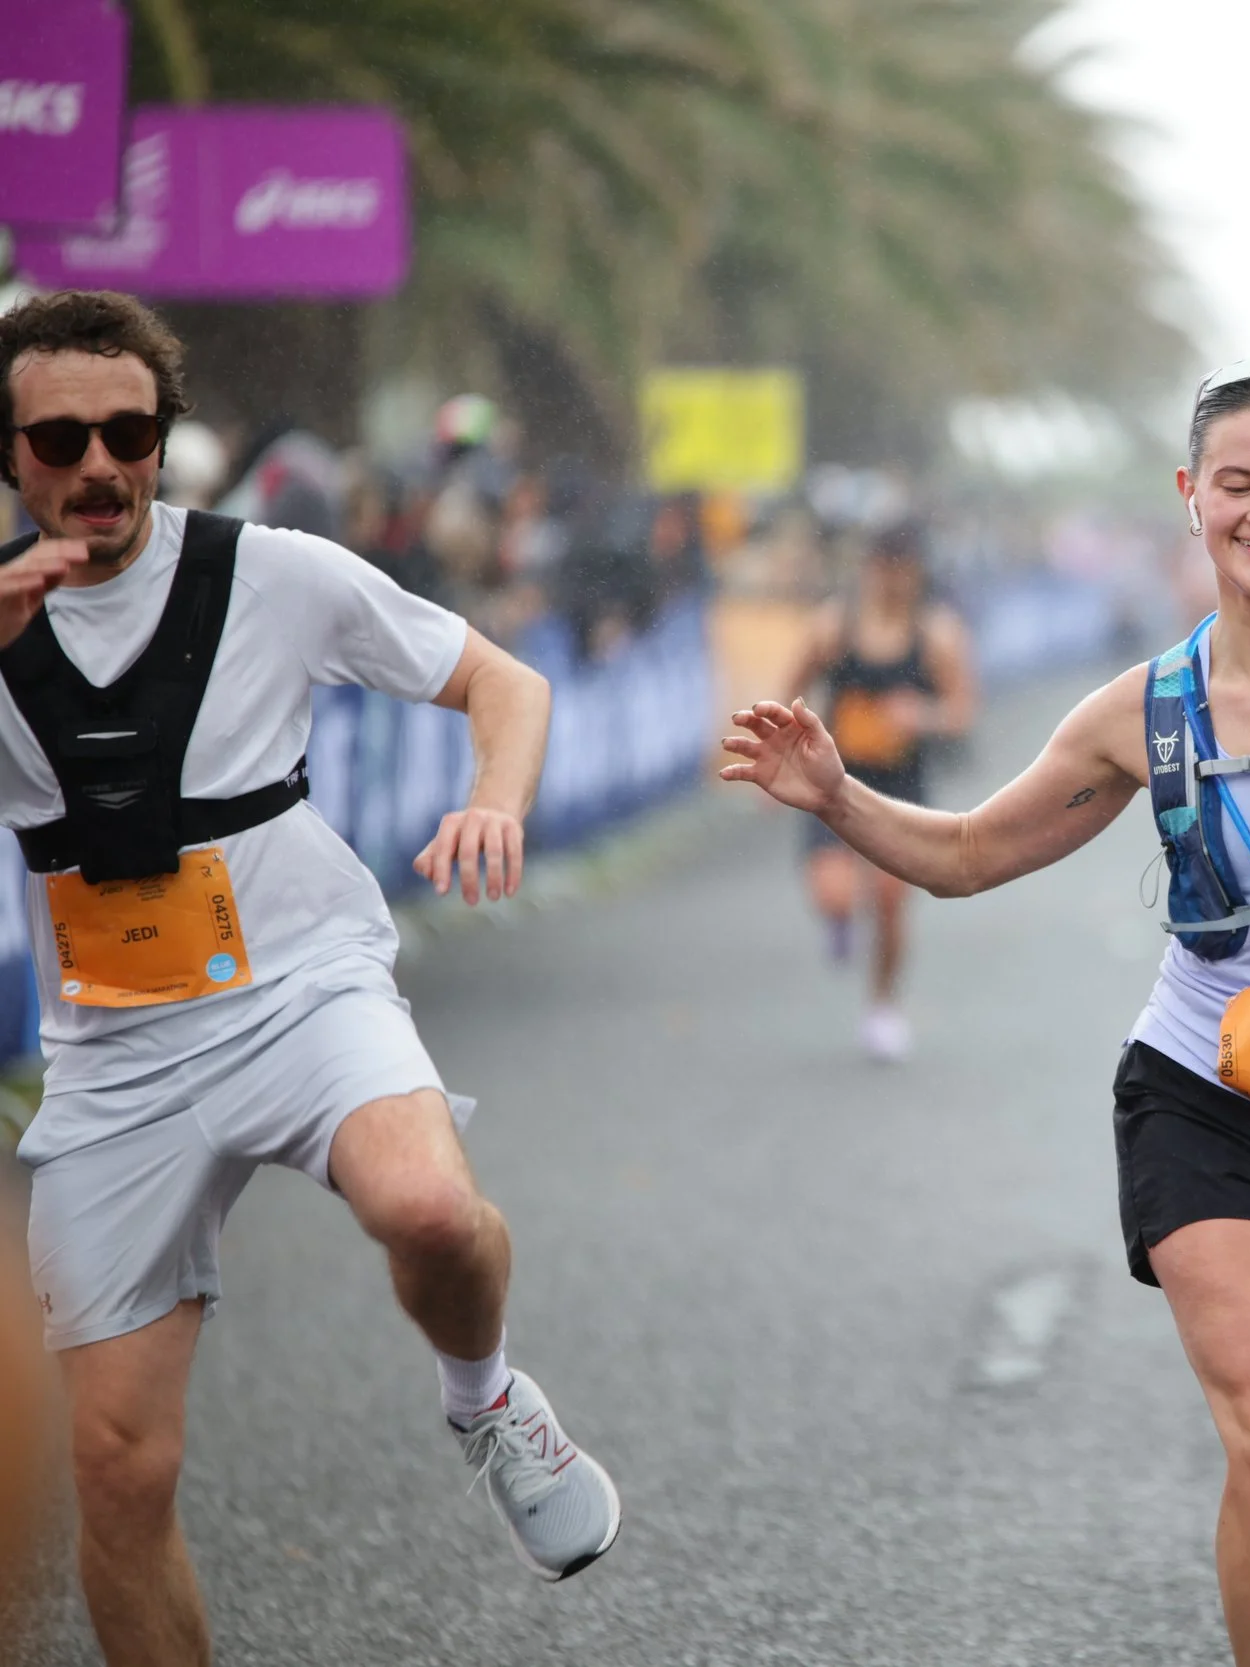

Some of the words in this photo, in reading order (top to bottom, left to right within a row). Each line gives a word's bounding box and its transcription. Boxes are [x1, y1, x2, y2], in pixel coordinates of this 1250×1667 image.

[121, 925, 159, 944] JEDI
[212, 894, 234, 941] 04275
[54, 922, 74, 969] 04275
[1221, 1033, 1233, 1077] 05530
